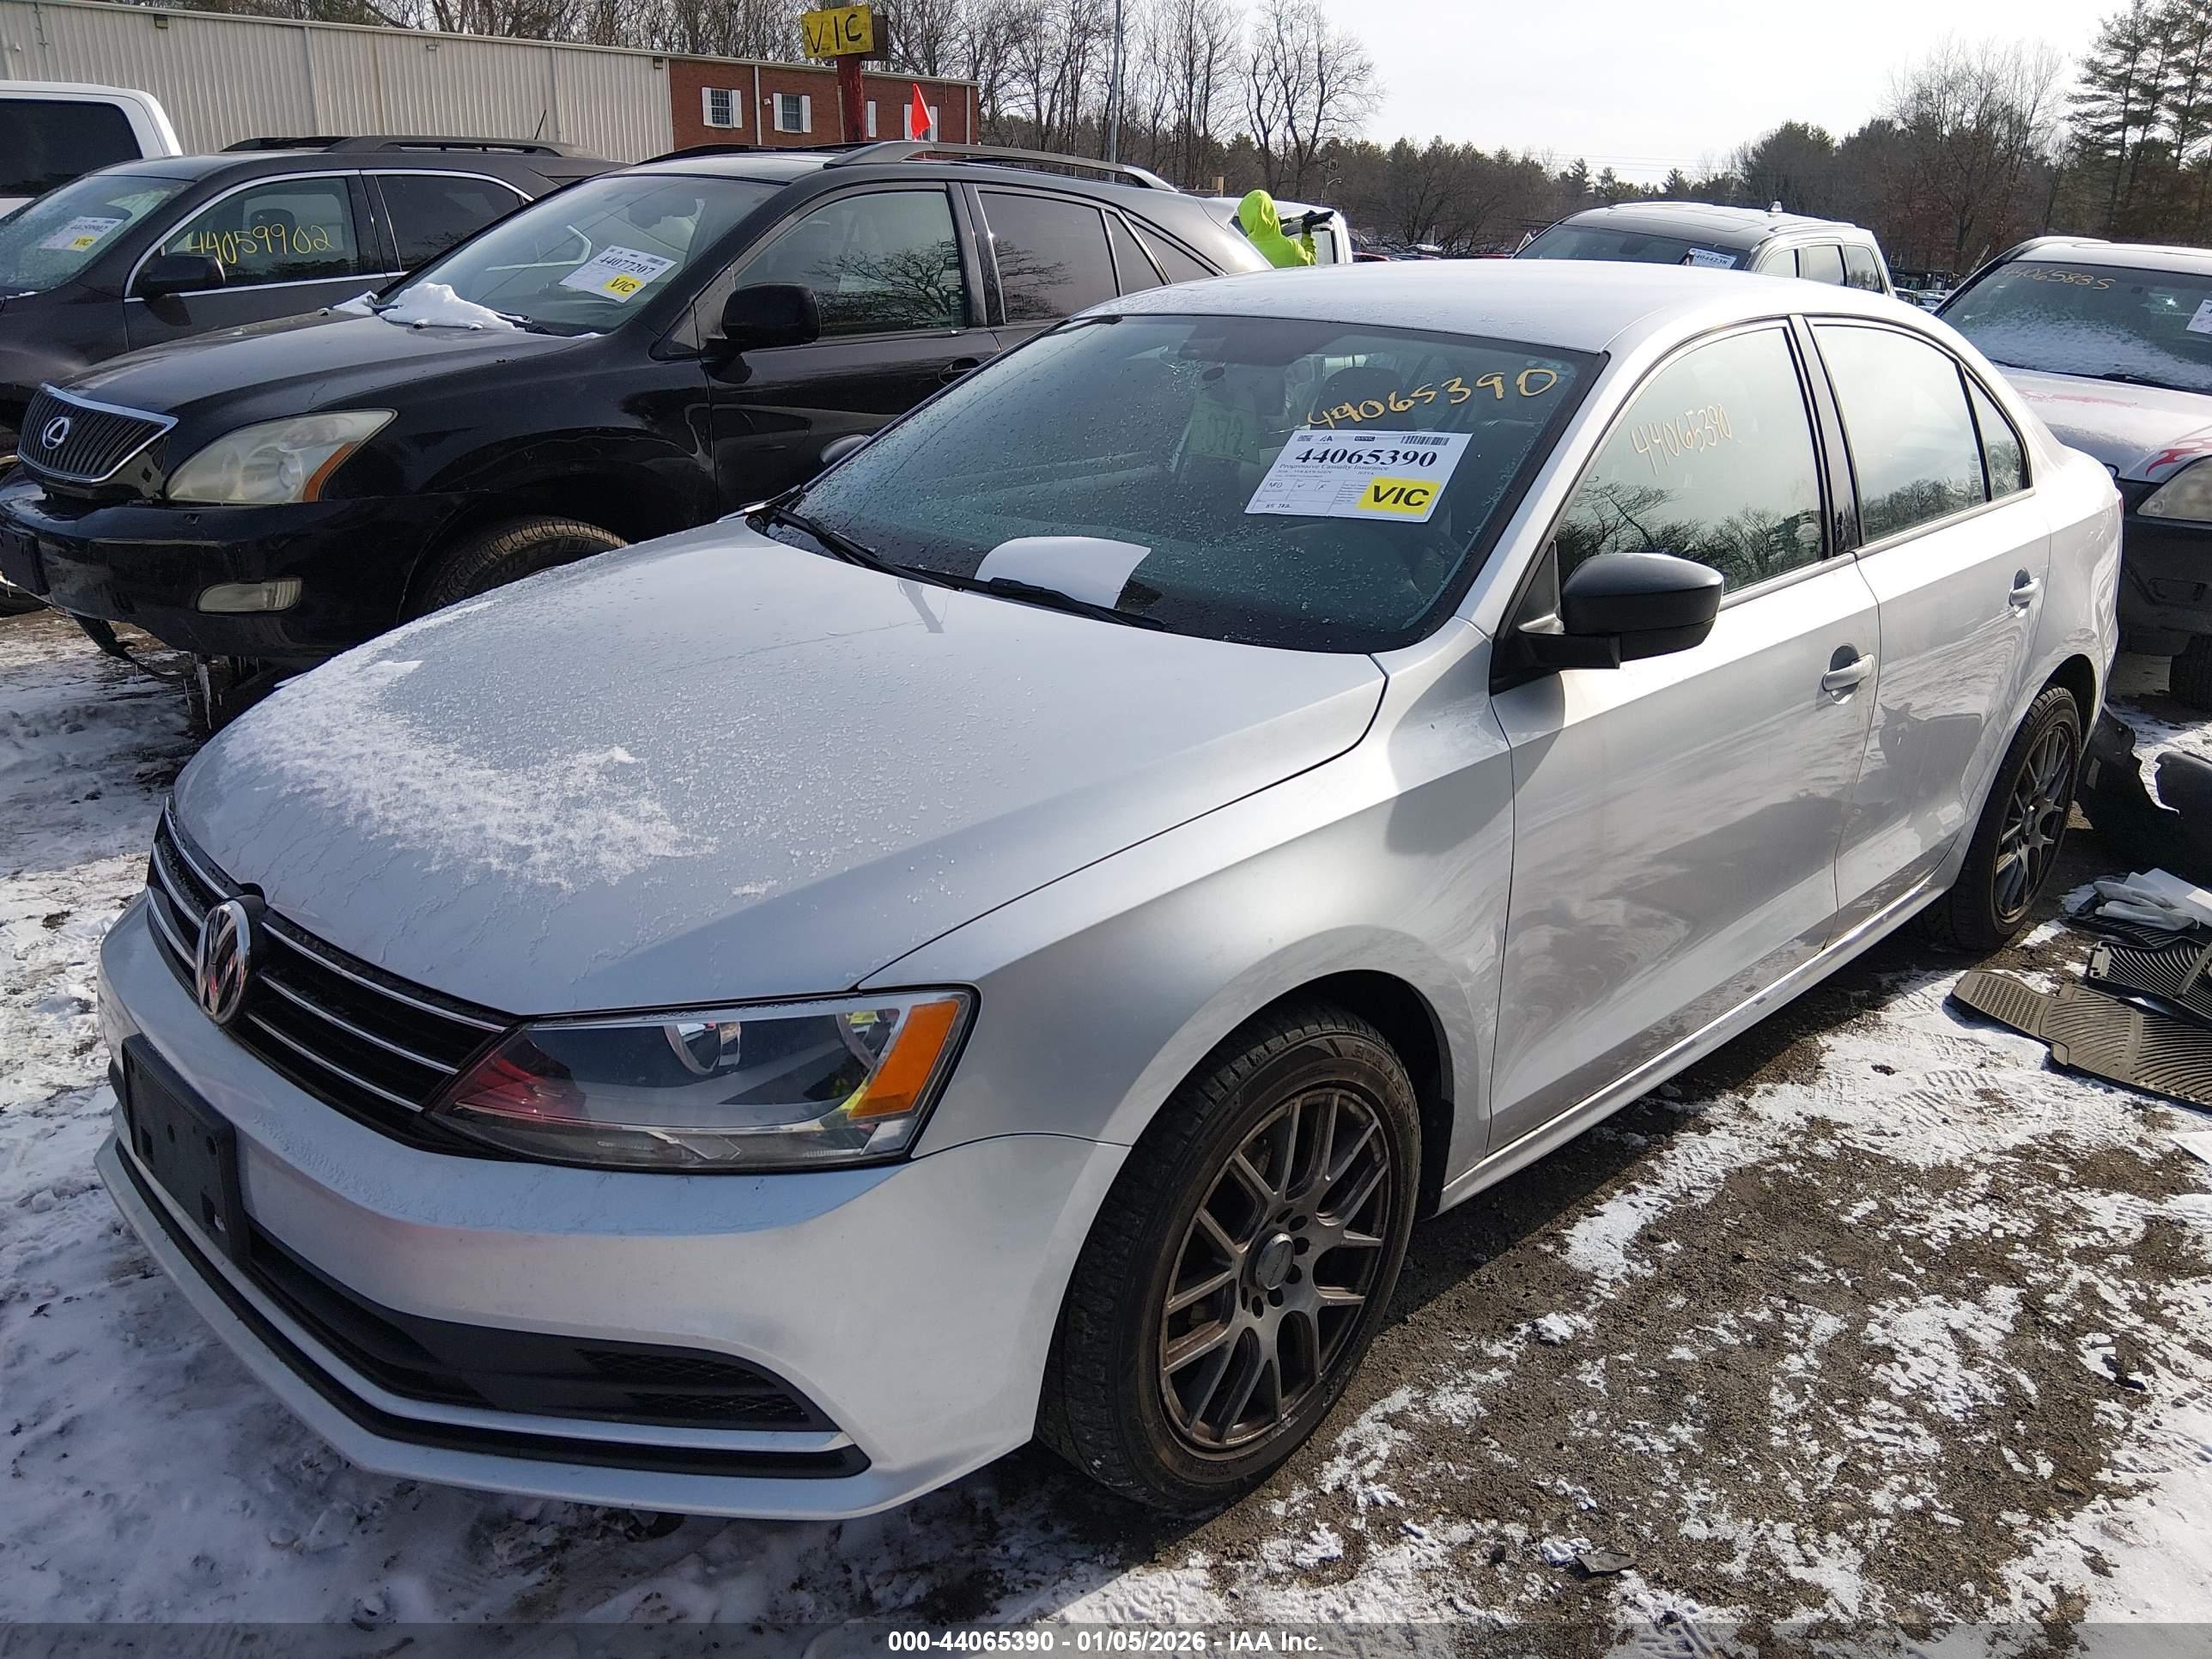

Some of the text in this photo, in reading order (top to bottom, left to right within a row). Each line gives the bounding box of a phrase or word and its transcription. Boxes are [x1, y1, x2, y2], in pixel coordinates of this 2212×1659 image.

[806, 13, 862, 53] VIC
[185, 223, 336, 264] 44059902
[599, 256, 656, 276] 44077207
[611, 277, 636, 293] VIC
[1630, 404, 1732, 476] 44065390
[1295, 447, 1438, 468] 44065390
[1372, 484, 1430, 507] VIC
